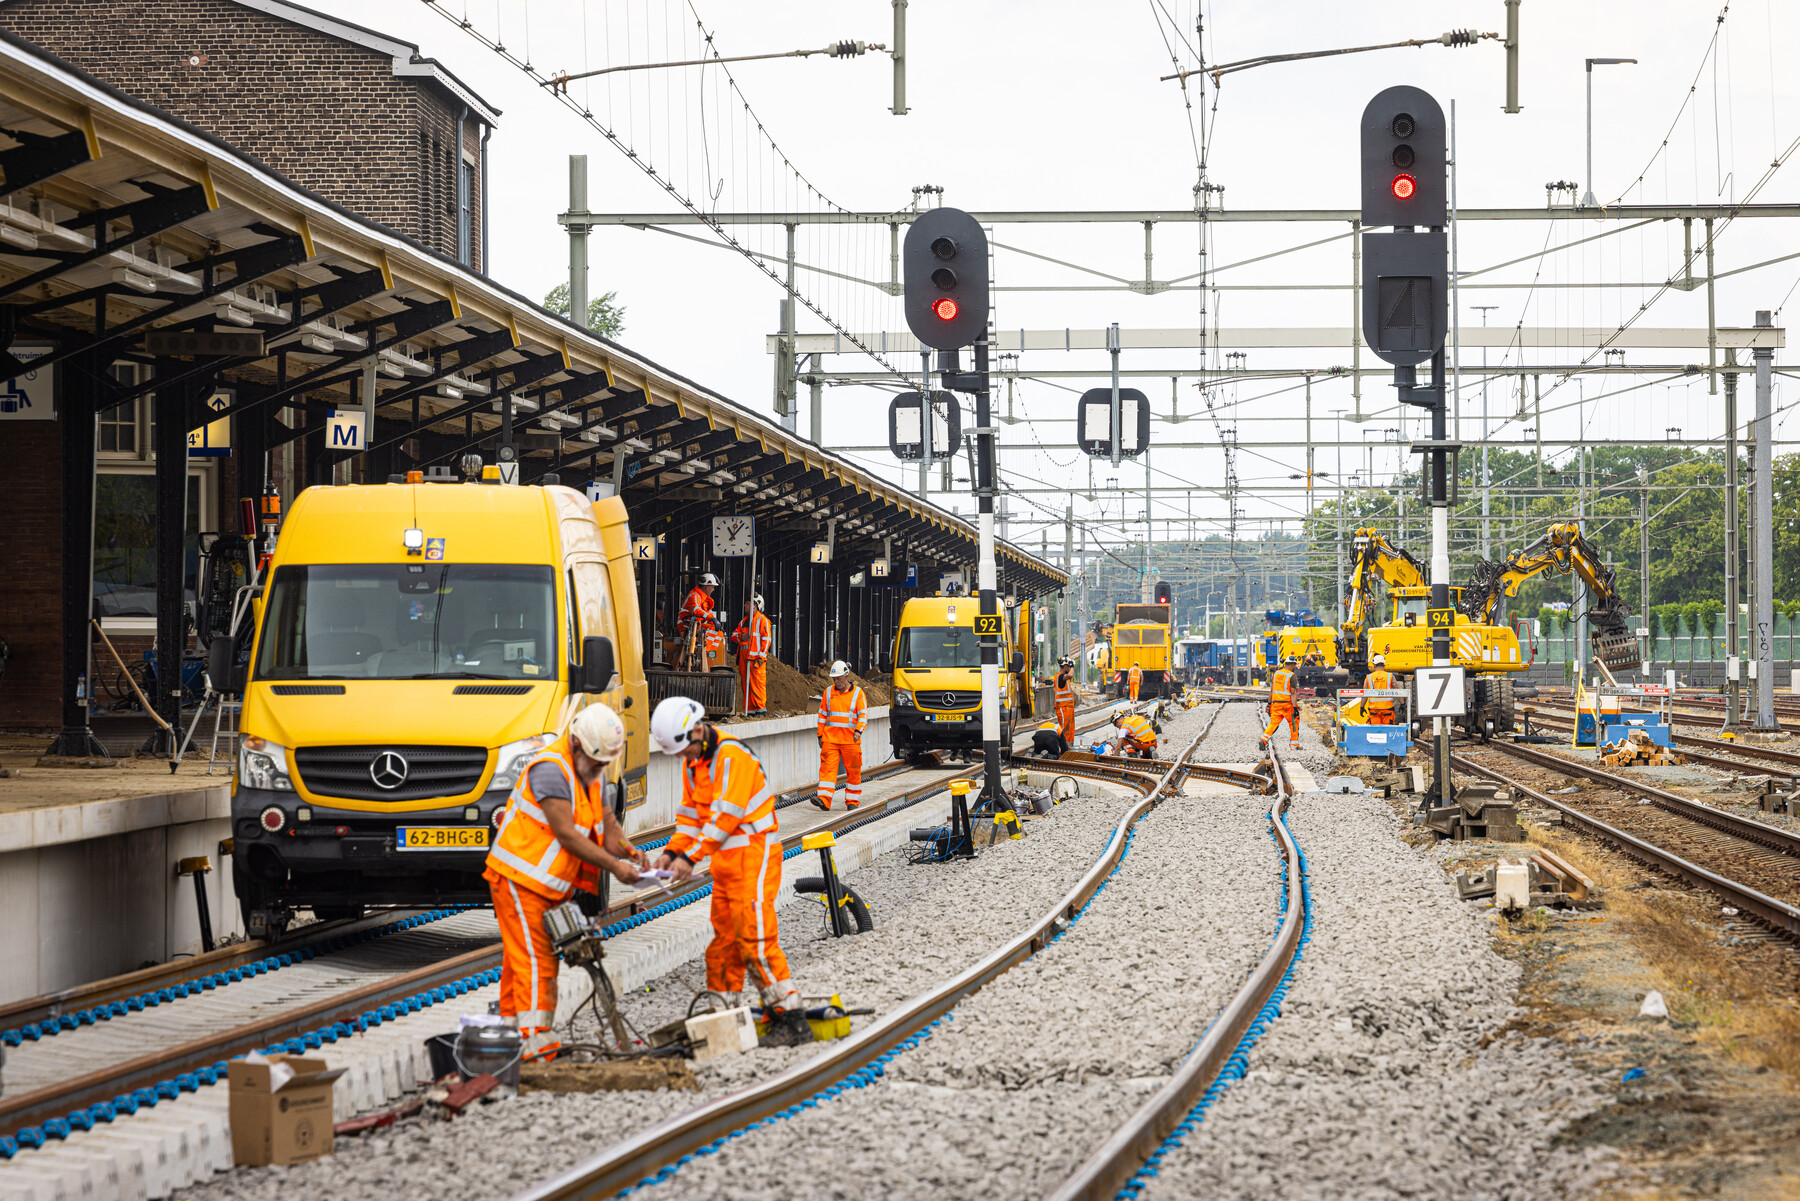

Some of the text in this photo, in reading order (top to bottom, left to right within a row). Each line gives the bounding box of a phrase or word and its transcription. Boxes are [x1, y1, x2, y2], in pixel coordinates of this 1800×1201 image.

[333, 424, 358, 446] M
[639, 545, 649, 558] K
[817, 551, 823, 562] J
[876, 566, 884, 575] H
[980, 618, 997, 632] 92
[1432, 612, 1450, 626] 94
[1429, 673, 1451, 710] 7
[410, 831, 484, 845] 62-BHG-8
